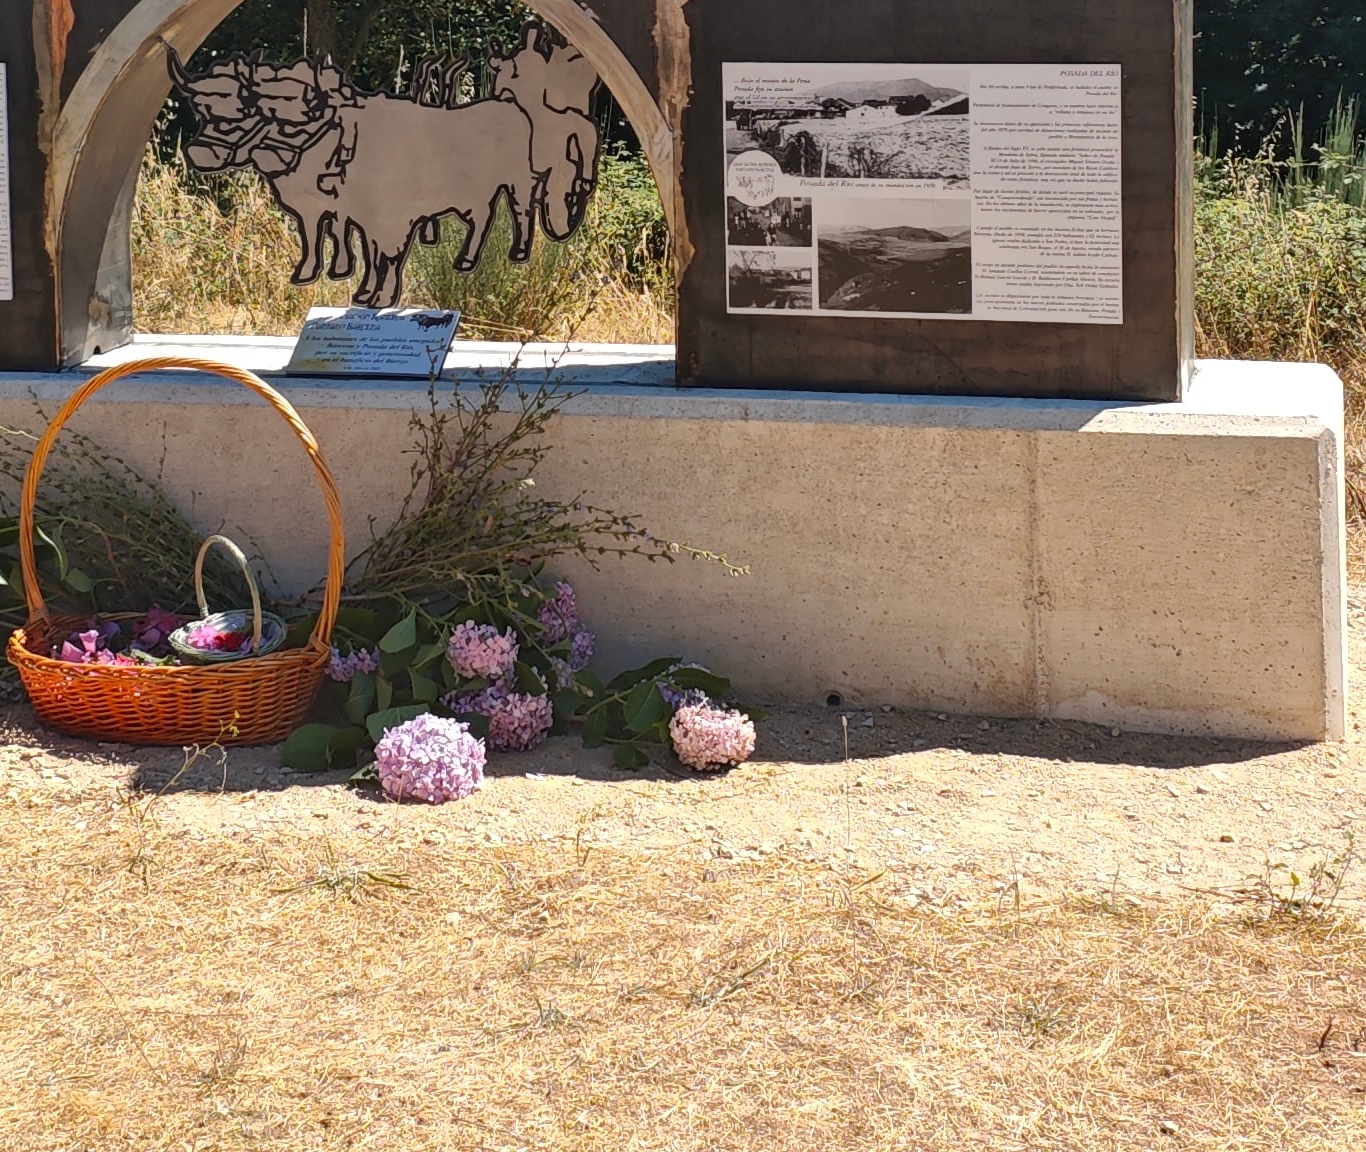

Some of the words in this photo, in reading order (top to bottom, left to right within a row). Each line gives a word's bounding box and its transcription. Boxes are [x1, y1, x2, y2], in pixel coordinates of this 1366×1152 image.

[799, 179, 825, 187] Posada
[827, 179, 839, 187] del
[359, 335, 369, 343] de
[379, 337, 407, 345] pueblos
[362, 342, 387, 350] Posada
[389, 342, 400, 351] del
[373, 358, 384, 366] del
